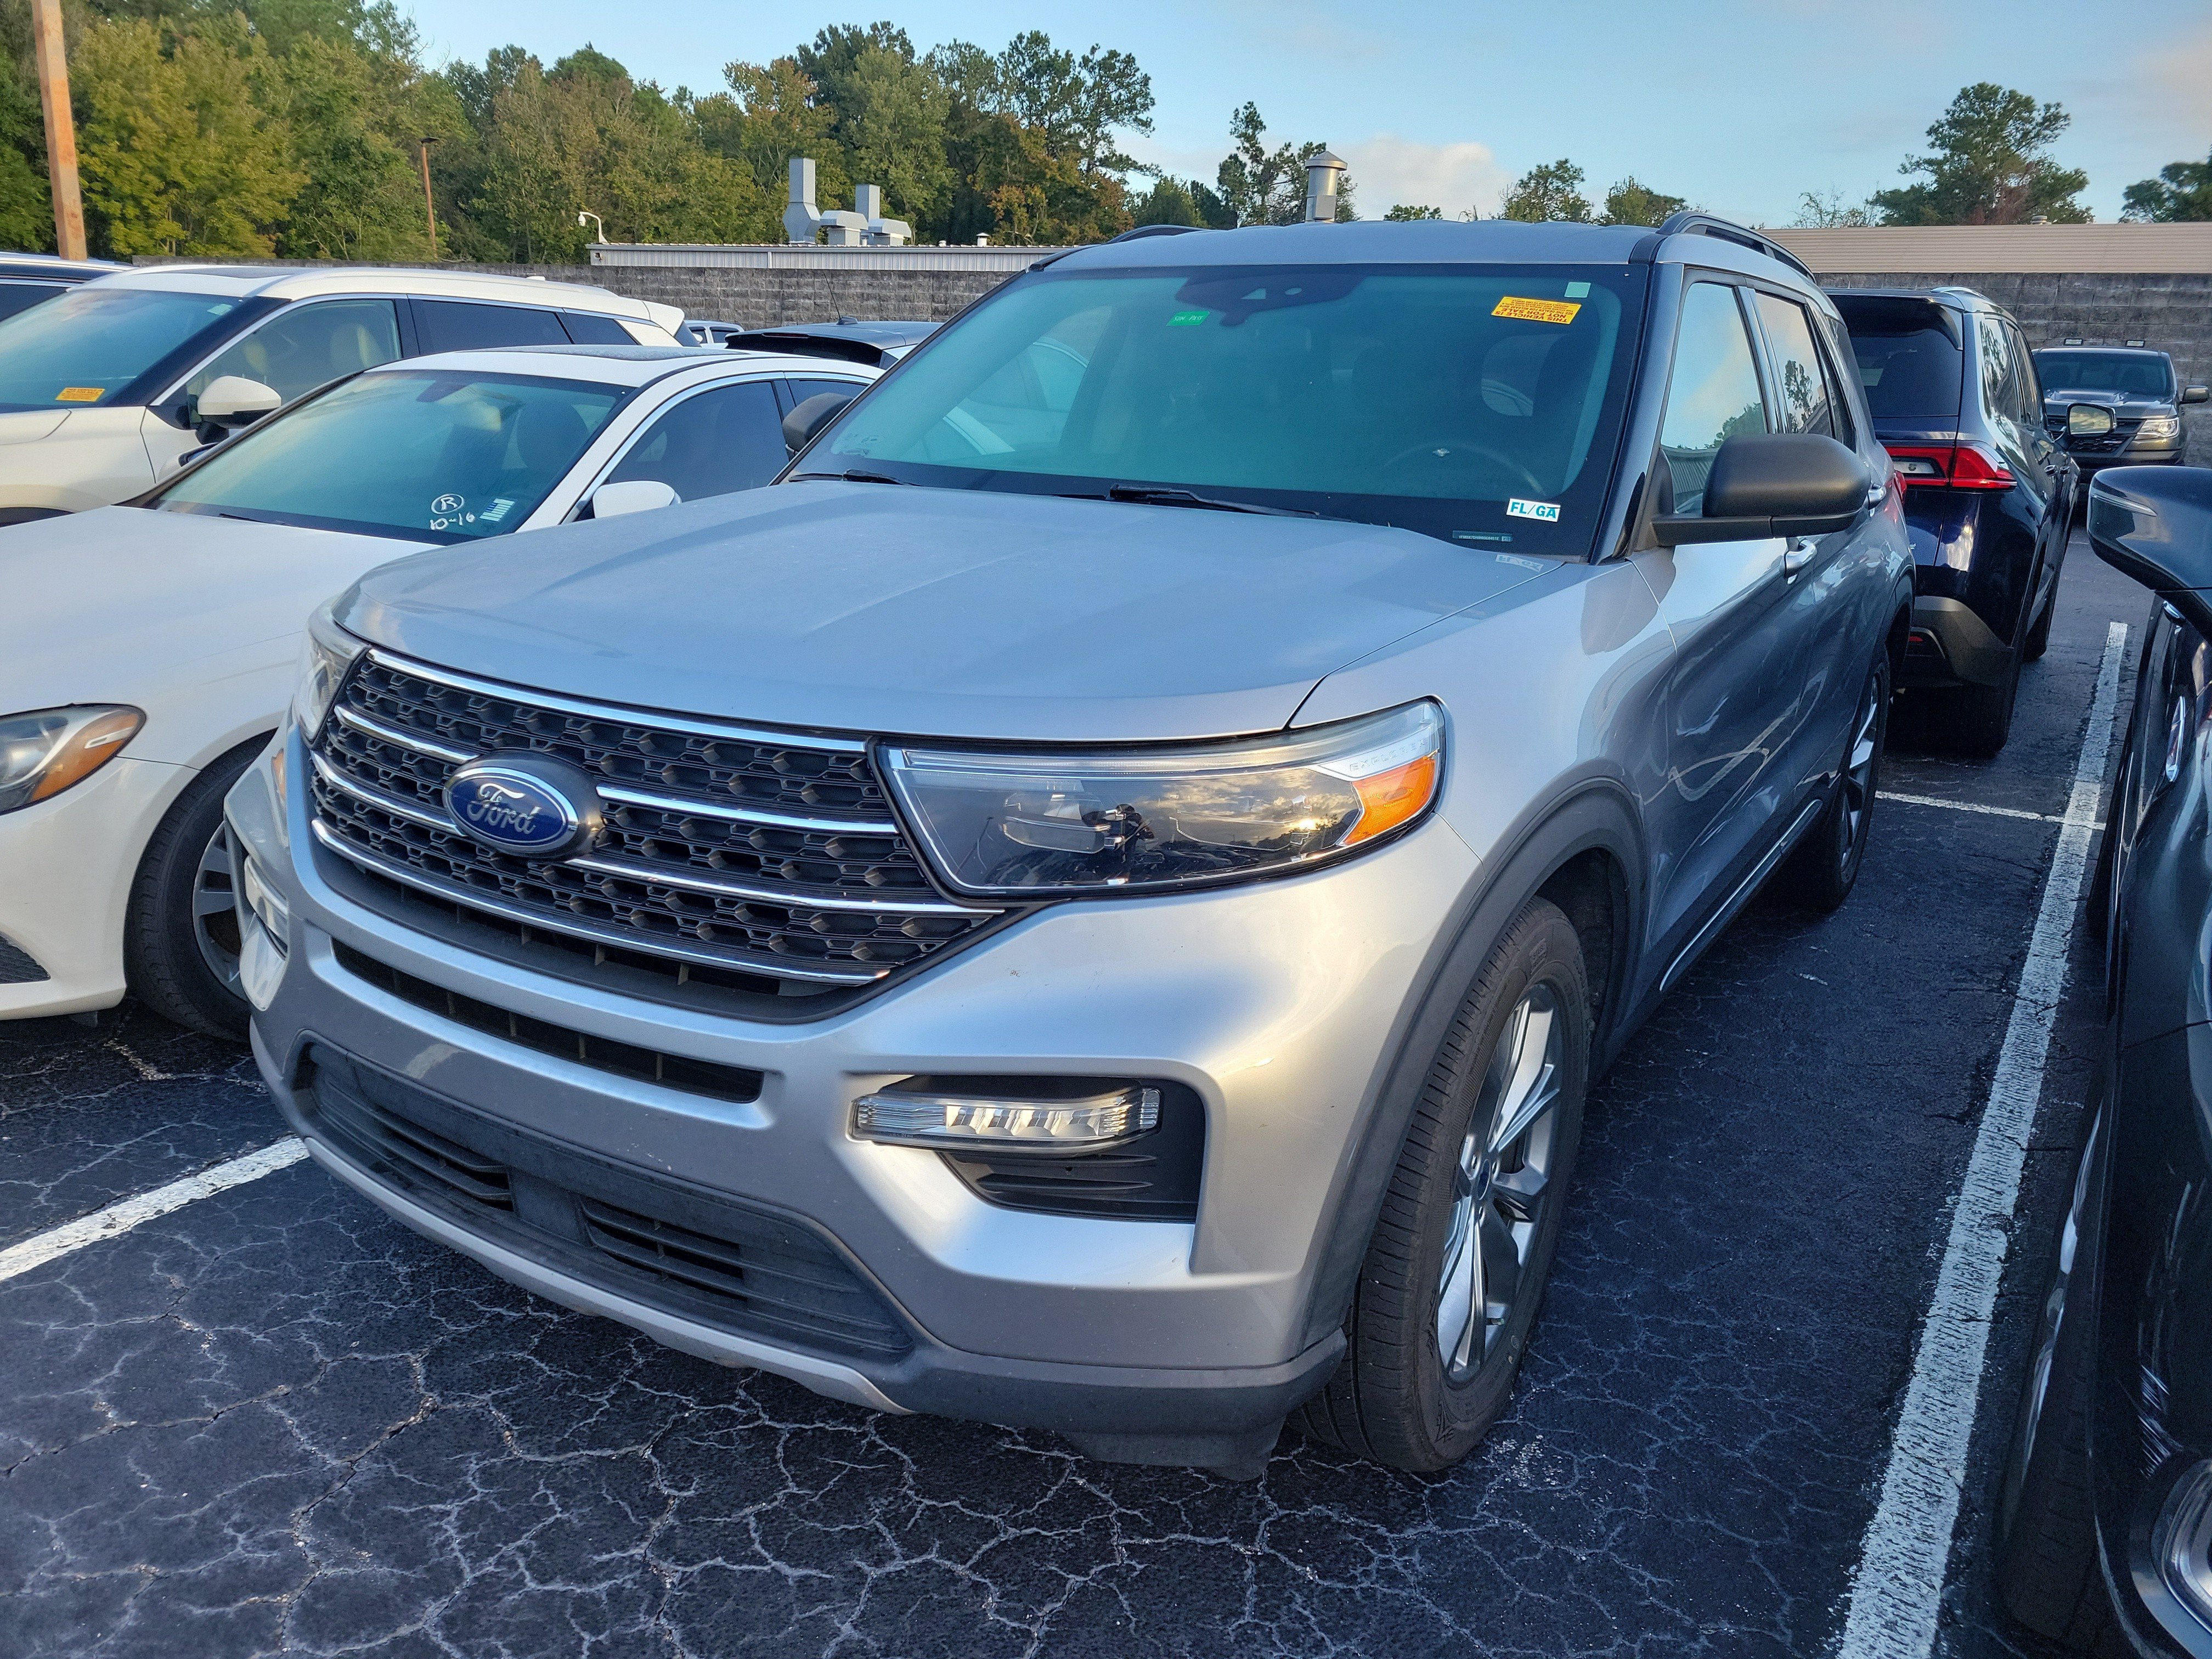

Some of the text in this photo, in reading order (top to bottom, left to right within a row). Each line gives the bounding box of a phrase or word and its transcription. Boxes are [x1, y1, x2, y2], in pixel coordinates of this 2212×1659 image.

[1510, 501, 1556, 519] FL/GA
[430, 511, 476, 531] 10-16
[466, 782, 543, 835] Ford
